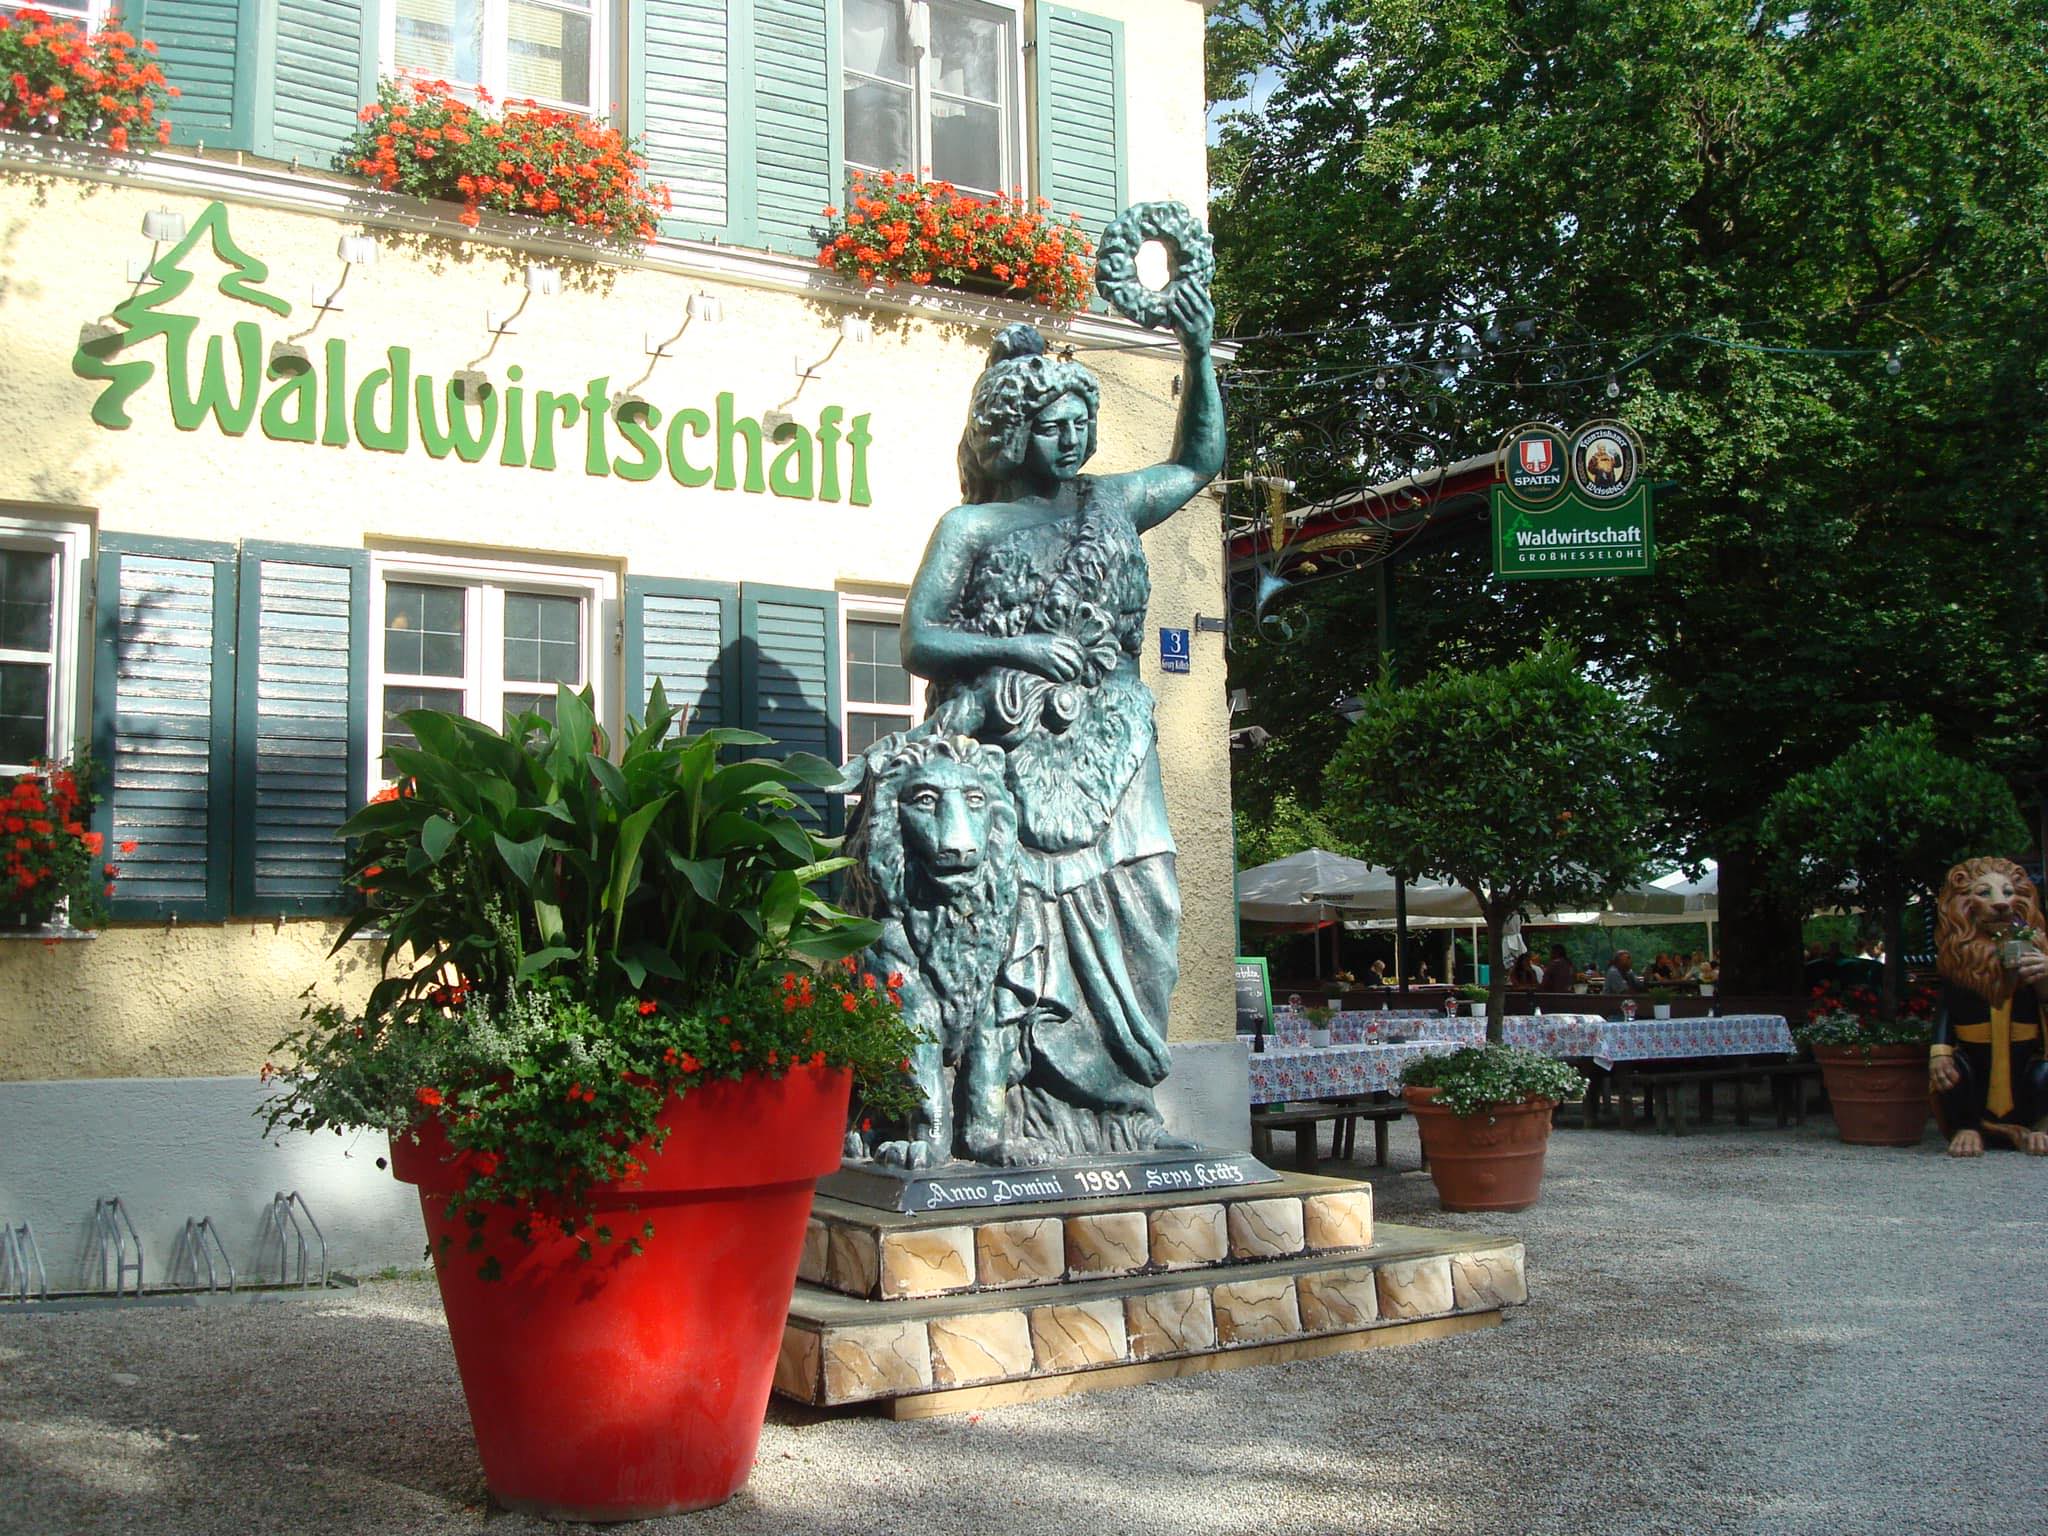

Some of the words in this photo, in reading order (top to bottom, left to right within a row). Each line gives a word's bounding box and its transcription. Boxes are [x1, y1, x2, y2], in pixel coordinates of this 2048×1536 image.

[165, 316, 873, 508] Waldwirtschaft
[1514, 474, 1560, 486] SPATEN
[1586, 481, 1624, 496] Weissbier
[1516, 525, 1641, 546] Waldwirtschaft
[1170, 632, 1182, 653] 3
[927, 1182, 988, 1209] Anno
[991, 1175, 1063, 1202] Domini
[1074, 1169, 1132, 1192] 1981
[1146, 1169, 1193, 1188] Sepp
[1194, 1163, 1244, 1186] Krätz
